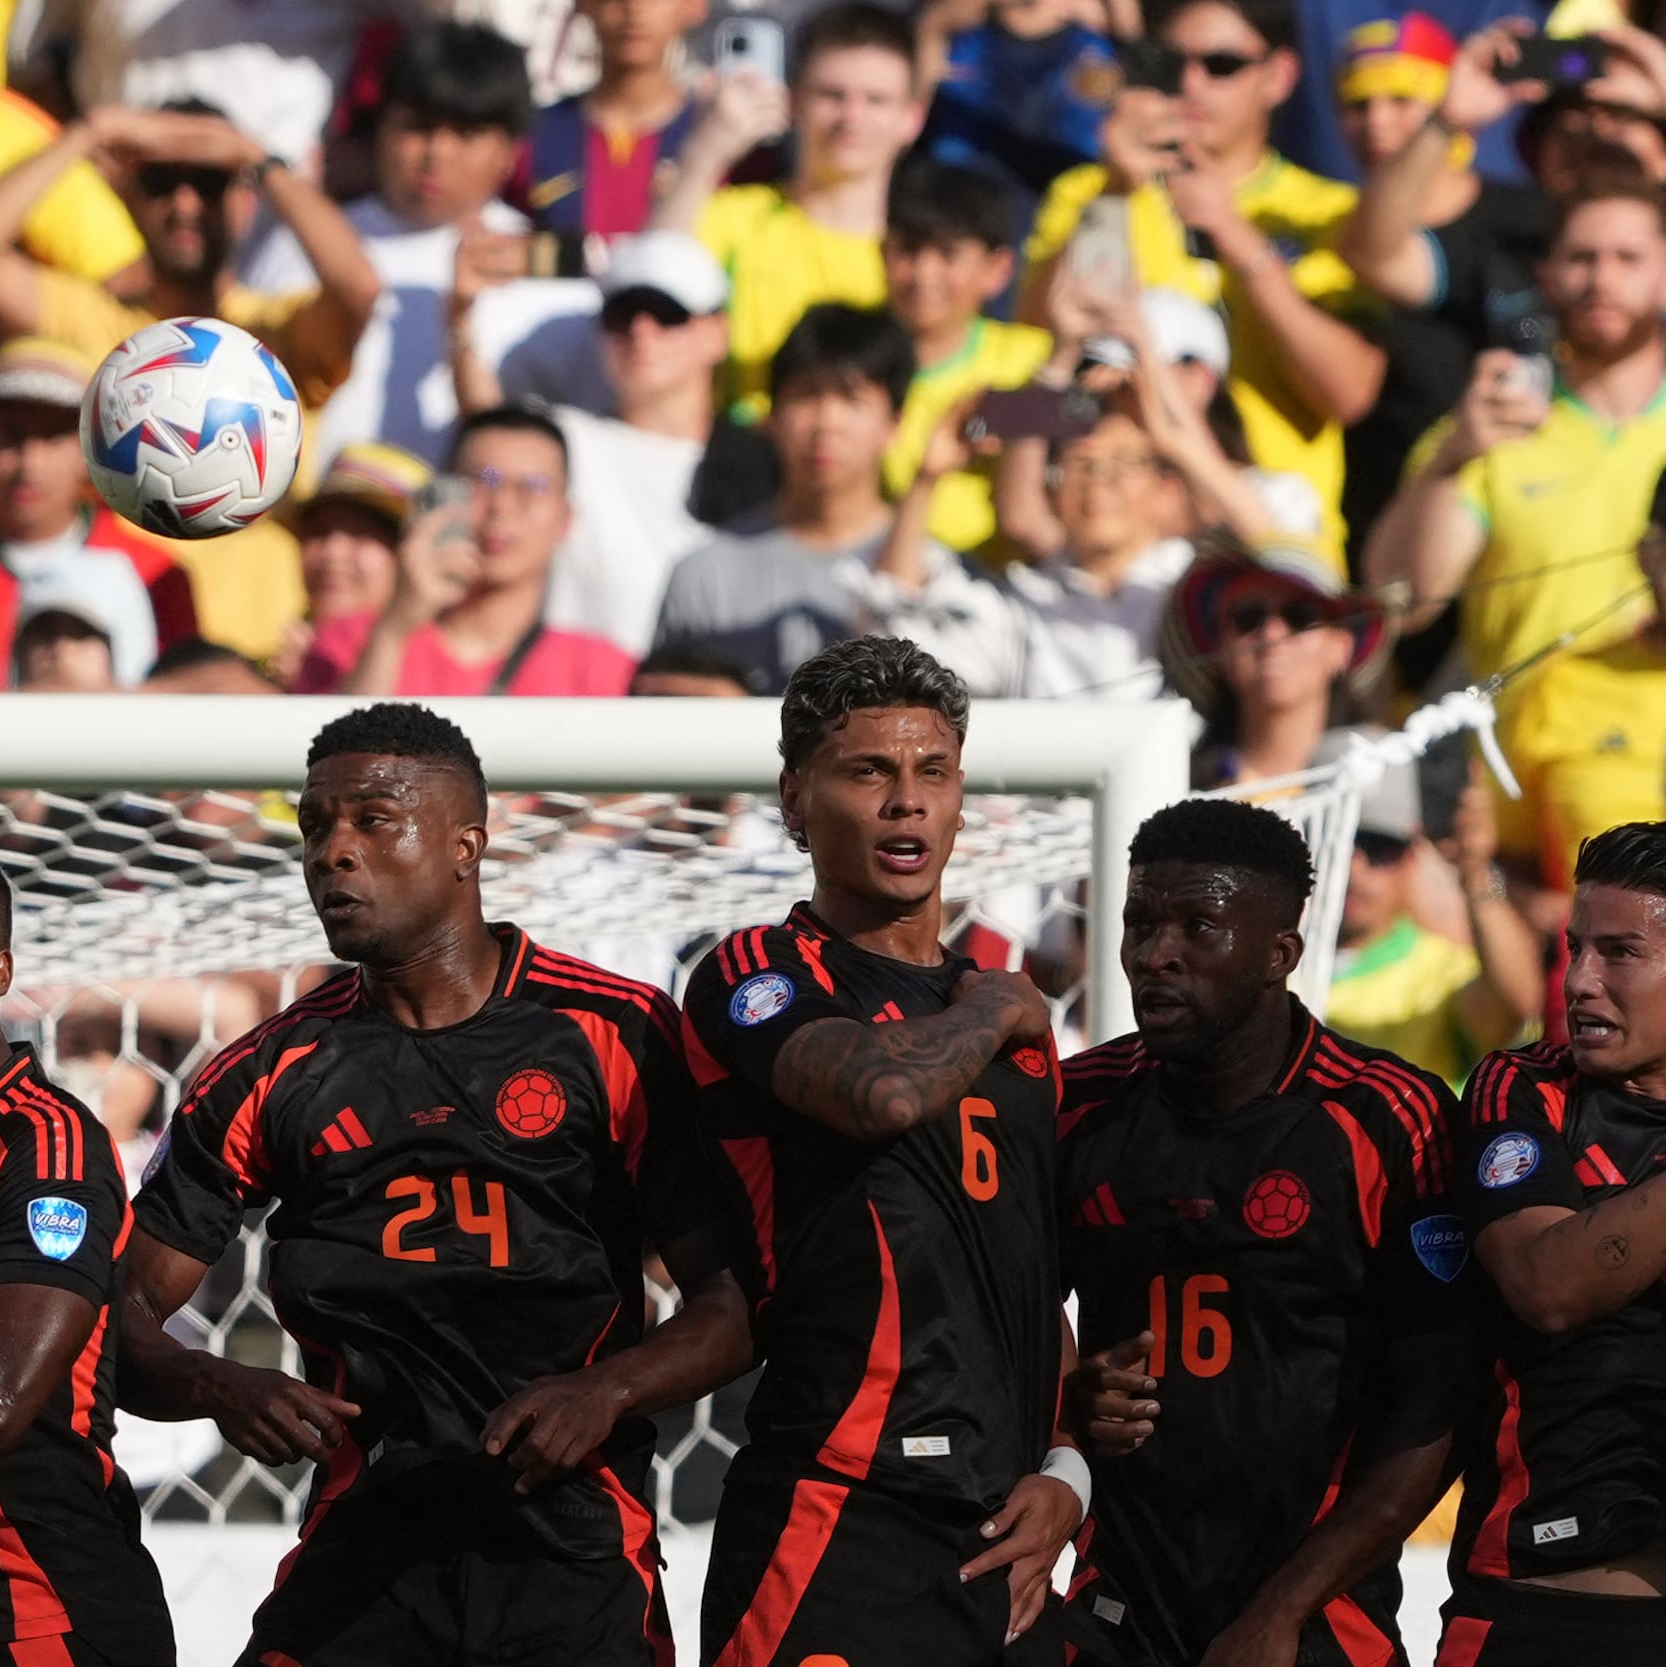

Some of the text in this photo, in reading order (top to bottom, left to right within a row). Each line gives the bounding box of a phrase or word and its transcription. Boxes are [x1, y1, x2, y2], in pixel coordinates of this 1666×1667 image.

[959, 1096, 999, 1202] 6
[35, 1212, 81, 1229] VIBRA
[382, 1167, 510, 1268] 24
[1420, 1230, 1466, 1247] VIBRA
[1148, 1273, 1233, 1379] 16
